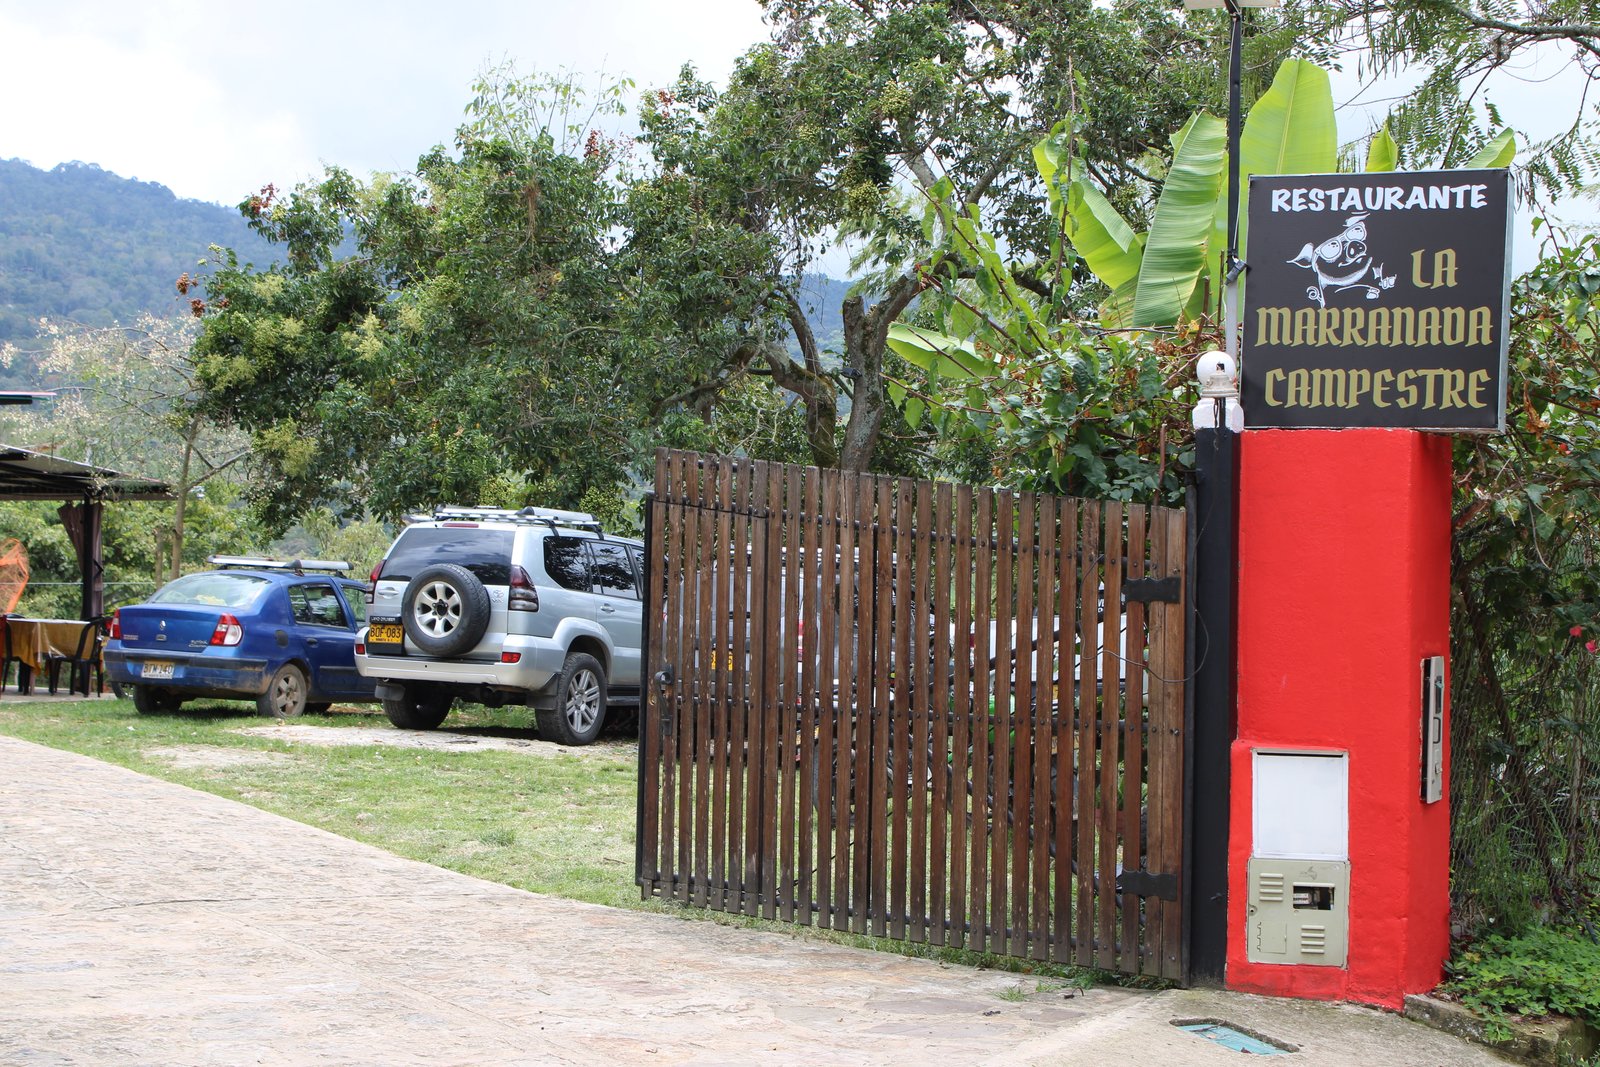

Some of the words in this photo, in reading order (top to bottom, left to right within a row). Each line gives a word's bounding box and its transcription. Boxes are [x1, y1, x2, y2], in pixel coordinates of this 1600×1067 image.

[1271, 184, 1488, 213] RESTAURANTE
[1411, 248, 1458, 290] LA
[1254, 306, 1494, 348] MARRANADA
[1264, 368, 1492, 410] CAMPESTRE
